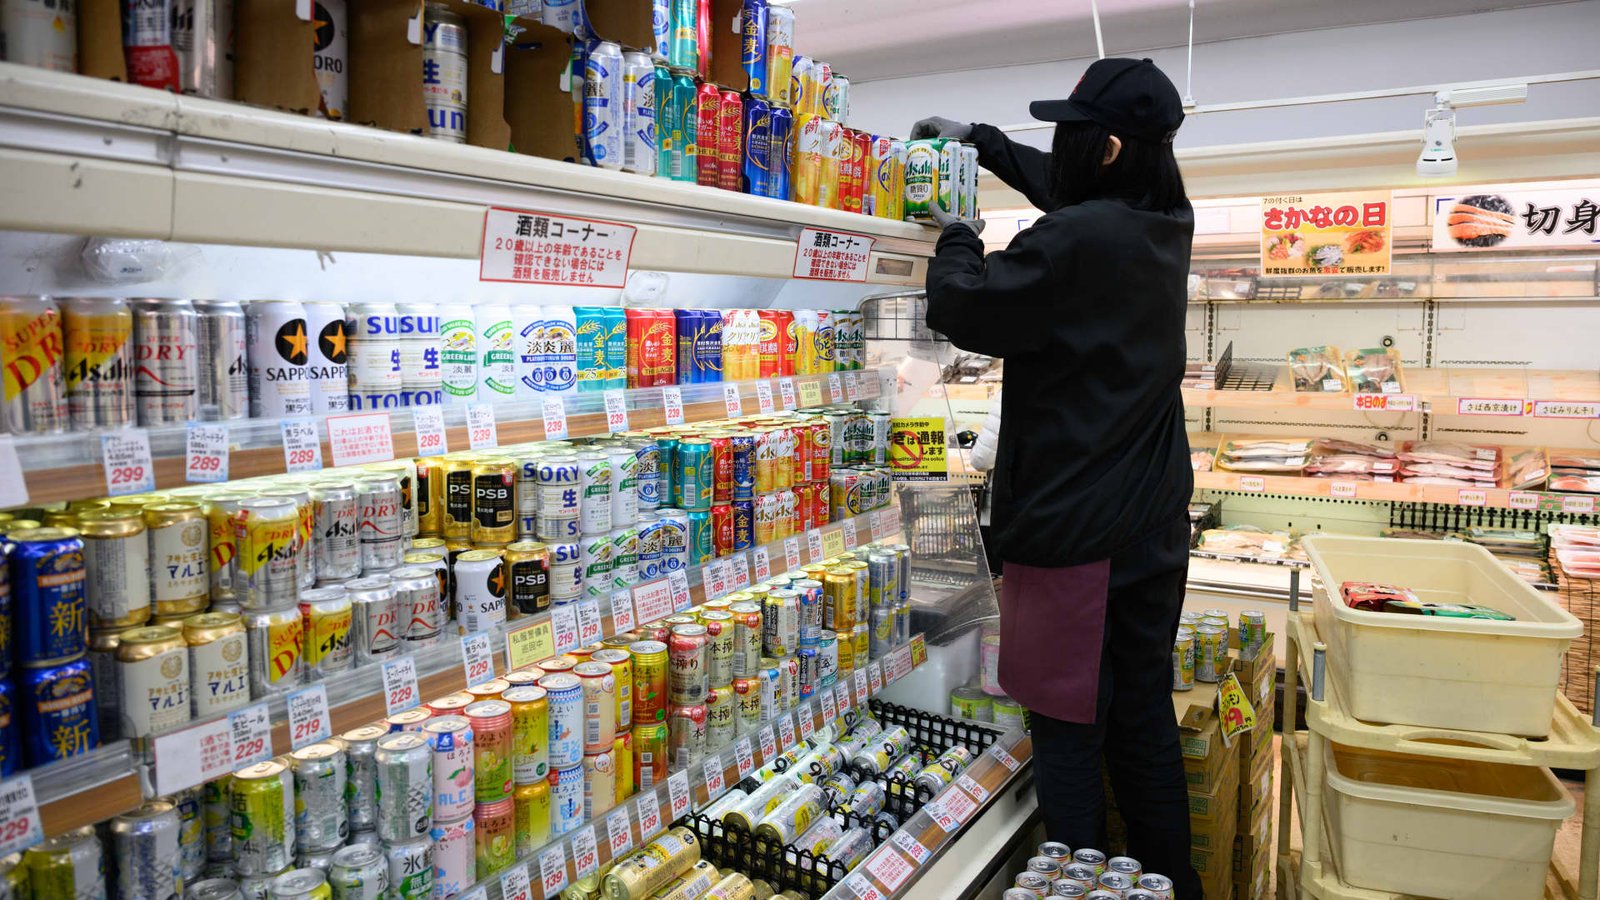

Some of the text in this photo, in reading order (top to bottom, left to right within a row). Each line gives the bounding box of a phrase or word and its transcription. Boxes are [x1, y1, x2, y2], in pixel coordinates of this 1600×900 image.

[1264, 202, 1386, 231] さかなの日
[1521, 198, 1600, 238] 切身
[515, 214, 609, 242] 酒類コーナー
[813, 232, 860, 250] 酒類コーナー
[513, 252, 605, 271] 確認できない場合には
[512, 266, 594, 283] 酒類を販売しません
[610, 412, 624, 425] 239
[667, 407, 680, 418] 239
[546, 420, 563, 432] 239
[420, 433, 441, 448] 289
[473, 428, 491, 442] 239
[189, 455, 221, 472] 289
[289, 449, 315, 466] 289
[111, 466, 144, 485] 299
[476, 488, 508, 500] PSB
[735, 514, 750, 543] 金麦
[515, 573, 547, 586] PSB
[712, 581, 725, 593] 189
[735, 572, 747, 585] 189
[674, 591, 688, 605] 189
[50, 598, 83, 637] 新
[615, 613, 630, 627] 189
[557, 632, 574, 647] 219
[582, 623, 598, 639] 219
[469, 660, 488, 680] 229
[389, 686, 413, 705] 229
[294, 718, 321, 741] 219
[234, 737, 263, 761] 229
[762, 744, 774, 757] 149
[739, 758, 751, 772] 149
[708, 776, 721, 791] 149
[673, 795, 688, 811] 139
[0, 817, 29, 845] 29
[642, 814, 657, 832] 139
[611, 831, 628, 850] 139
[403, 853, 421, 874] 氷
[576, 852, 594, 870] 139
[544, 870, 563, 891] 139
